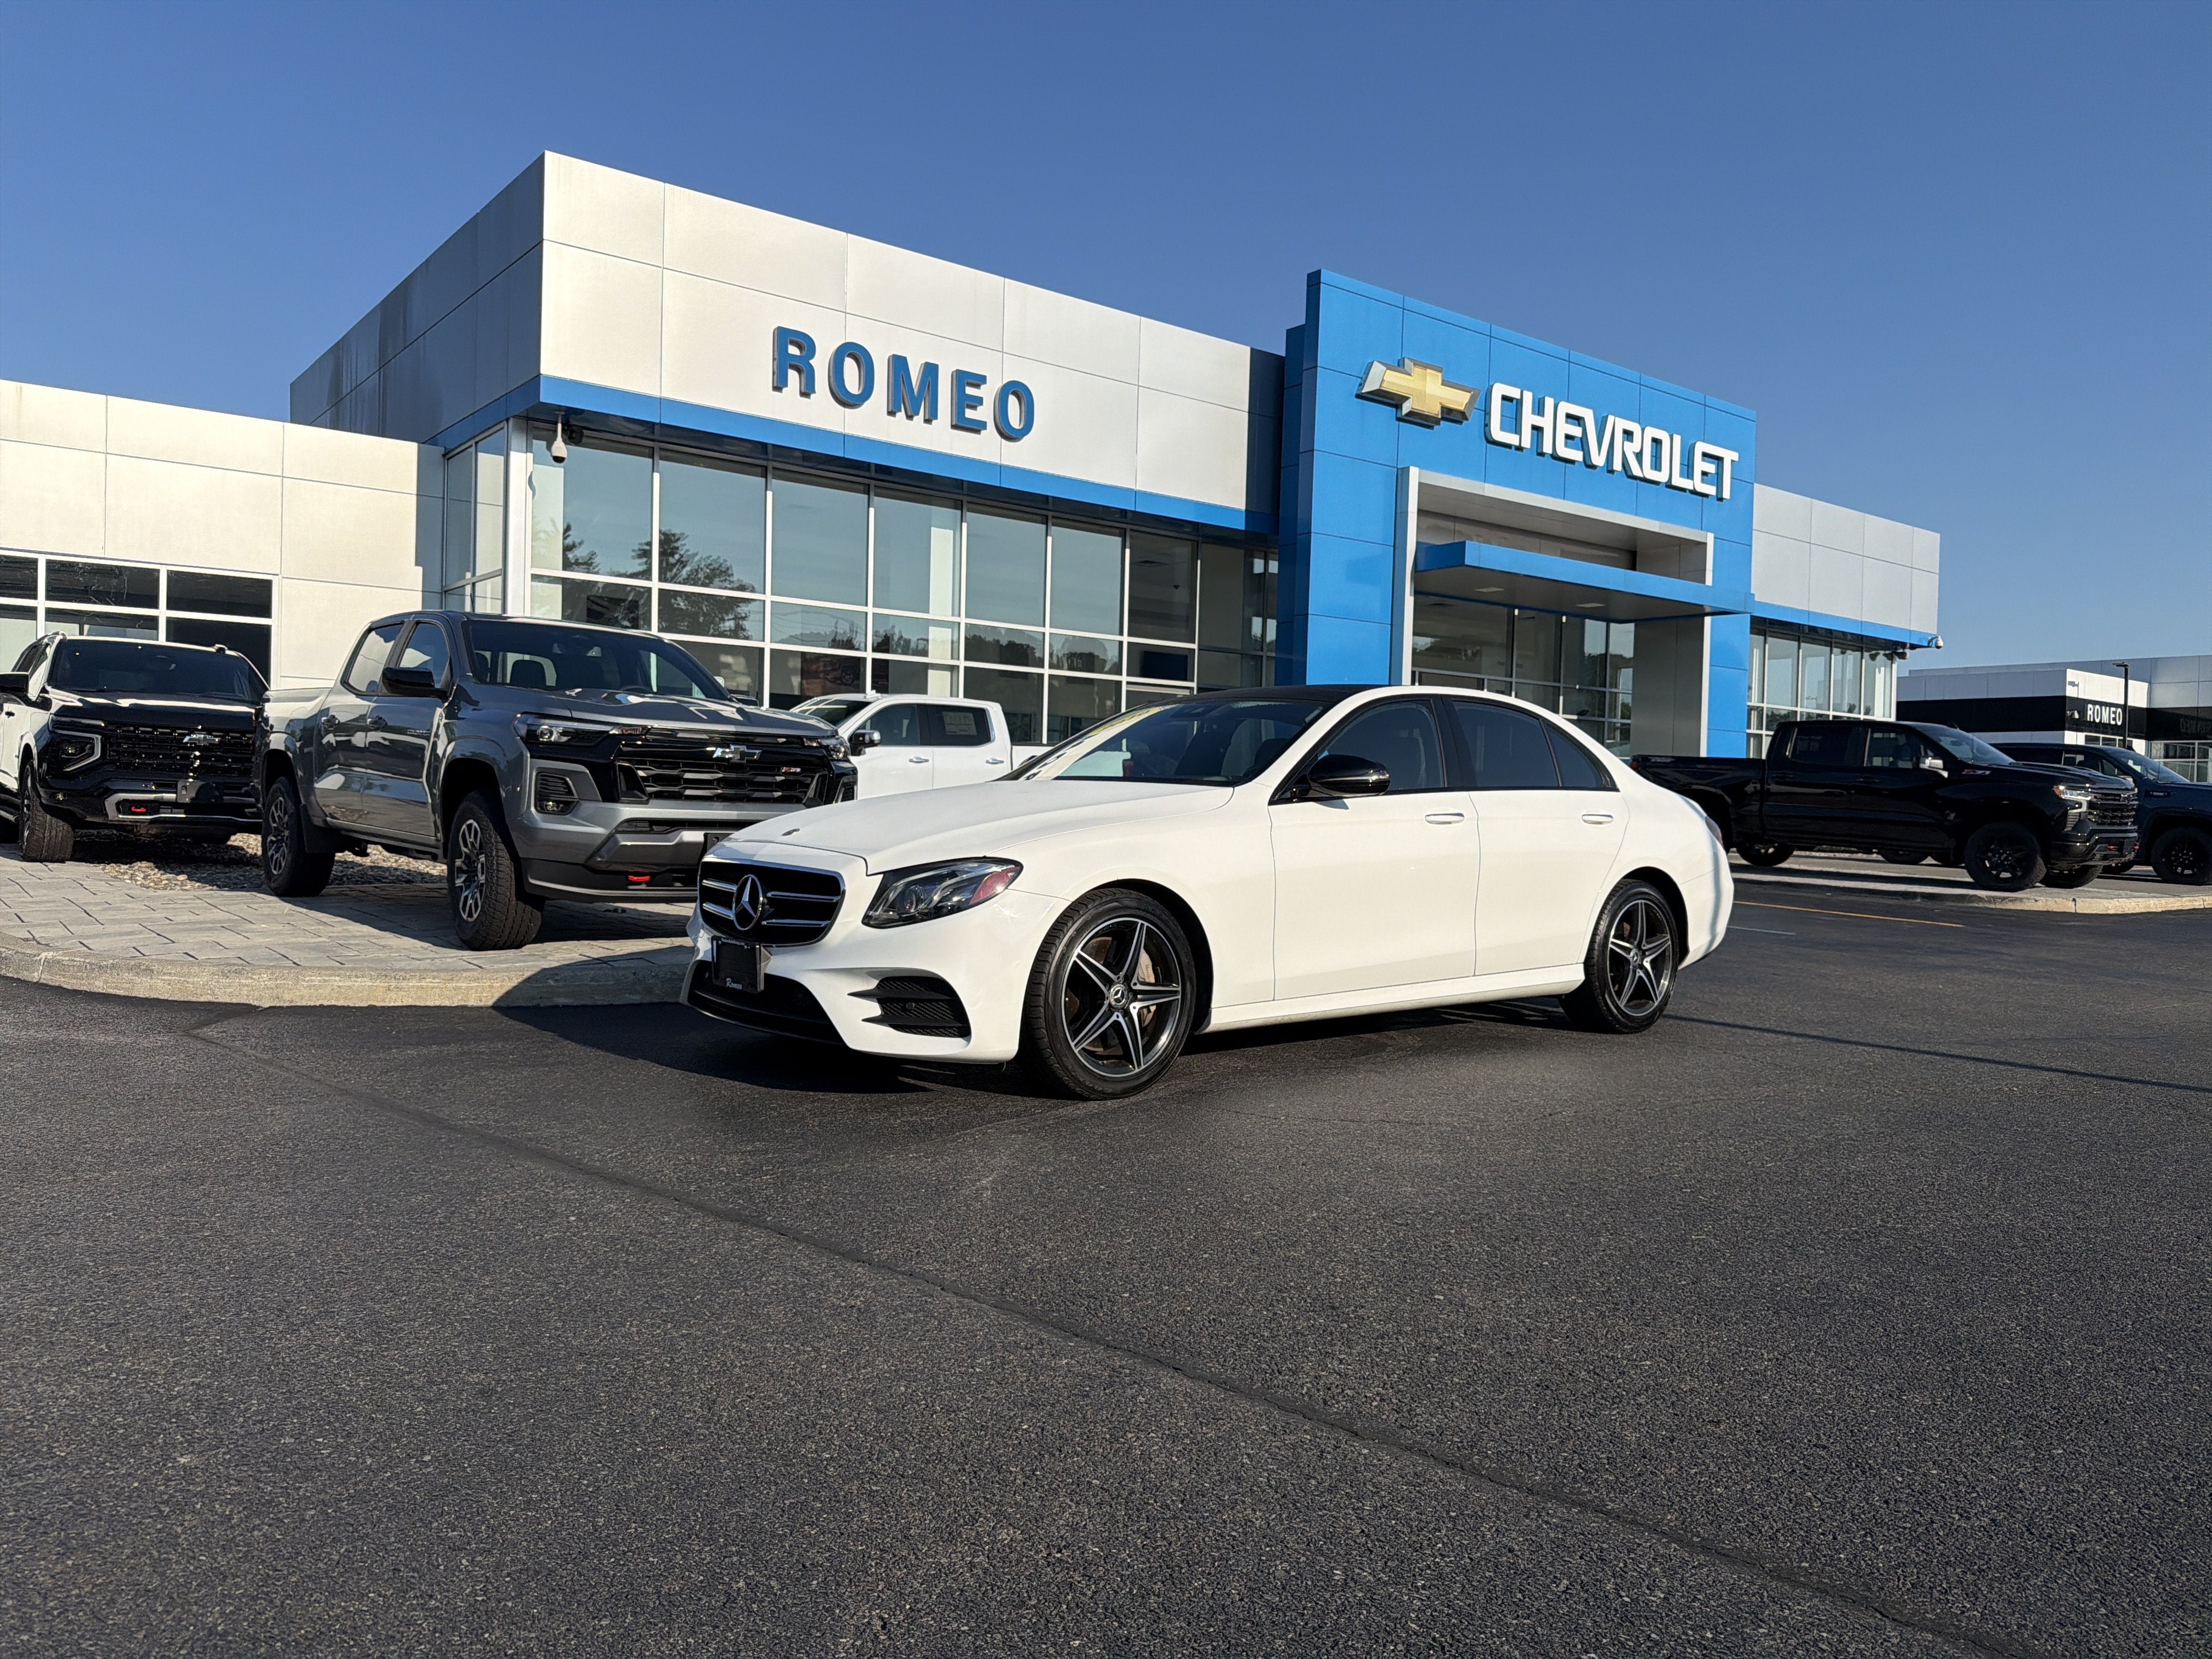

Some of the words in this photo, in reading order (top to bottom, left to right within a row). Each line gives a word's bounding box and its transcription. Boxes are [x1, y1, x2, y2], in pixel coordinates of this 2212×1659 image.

[772, 326, 1034, 441] ROMEO
[1488, 382, 1739, 499] CHEVROLET
[2087, 703, 2123, 726] ROMEO
